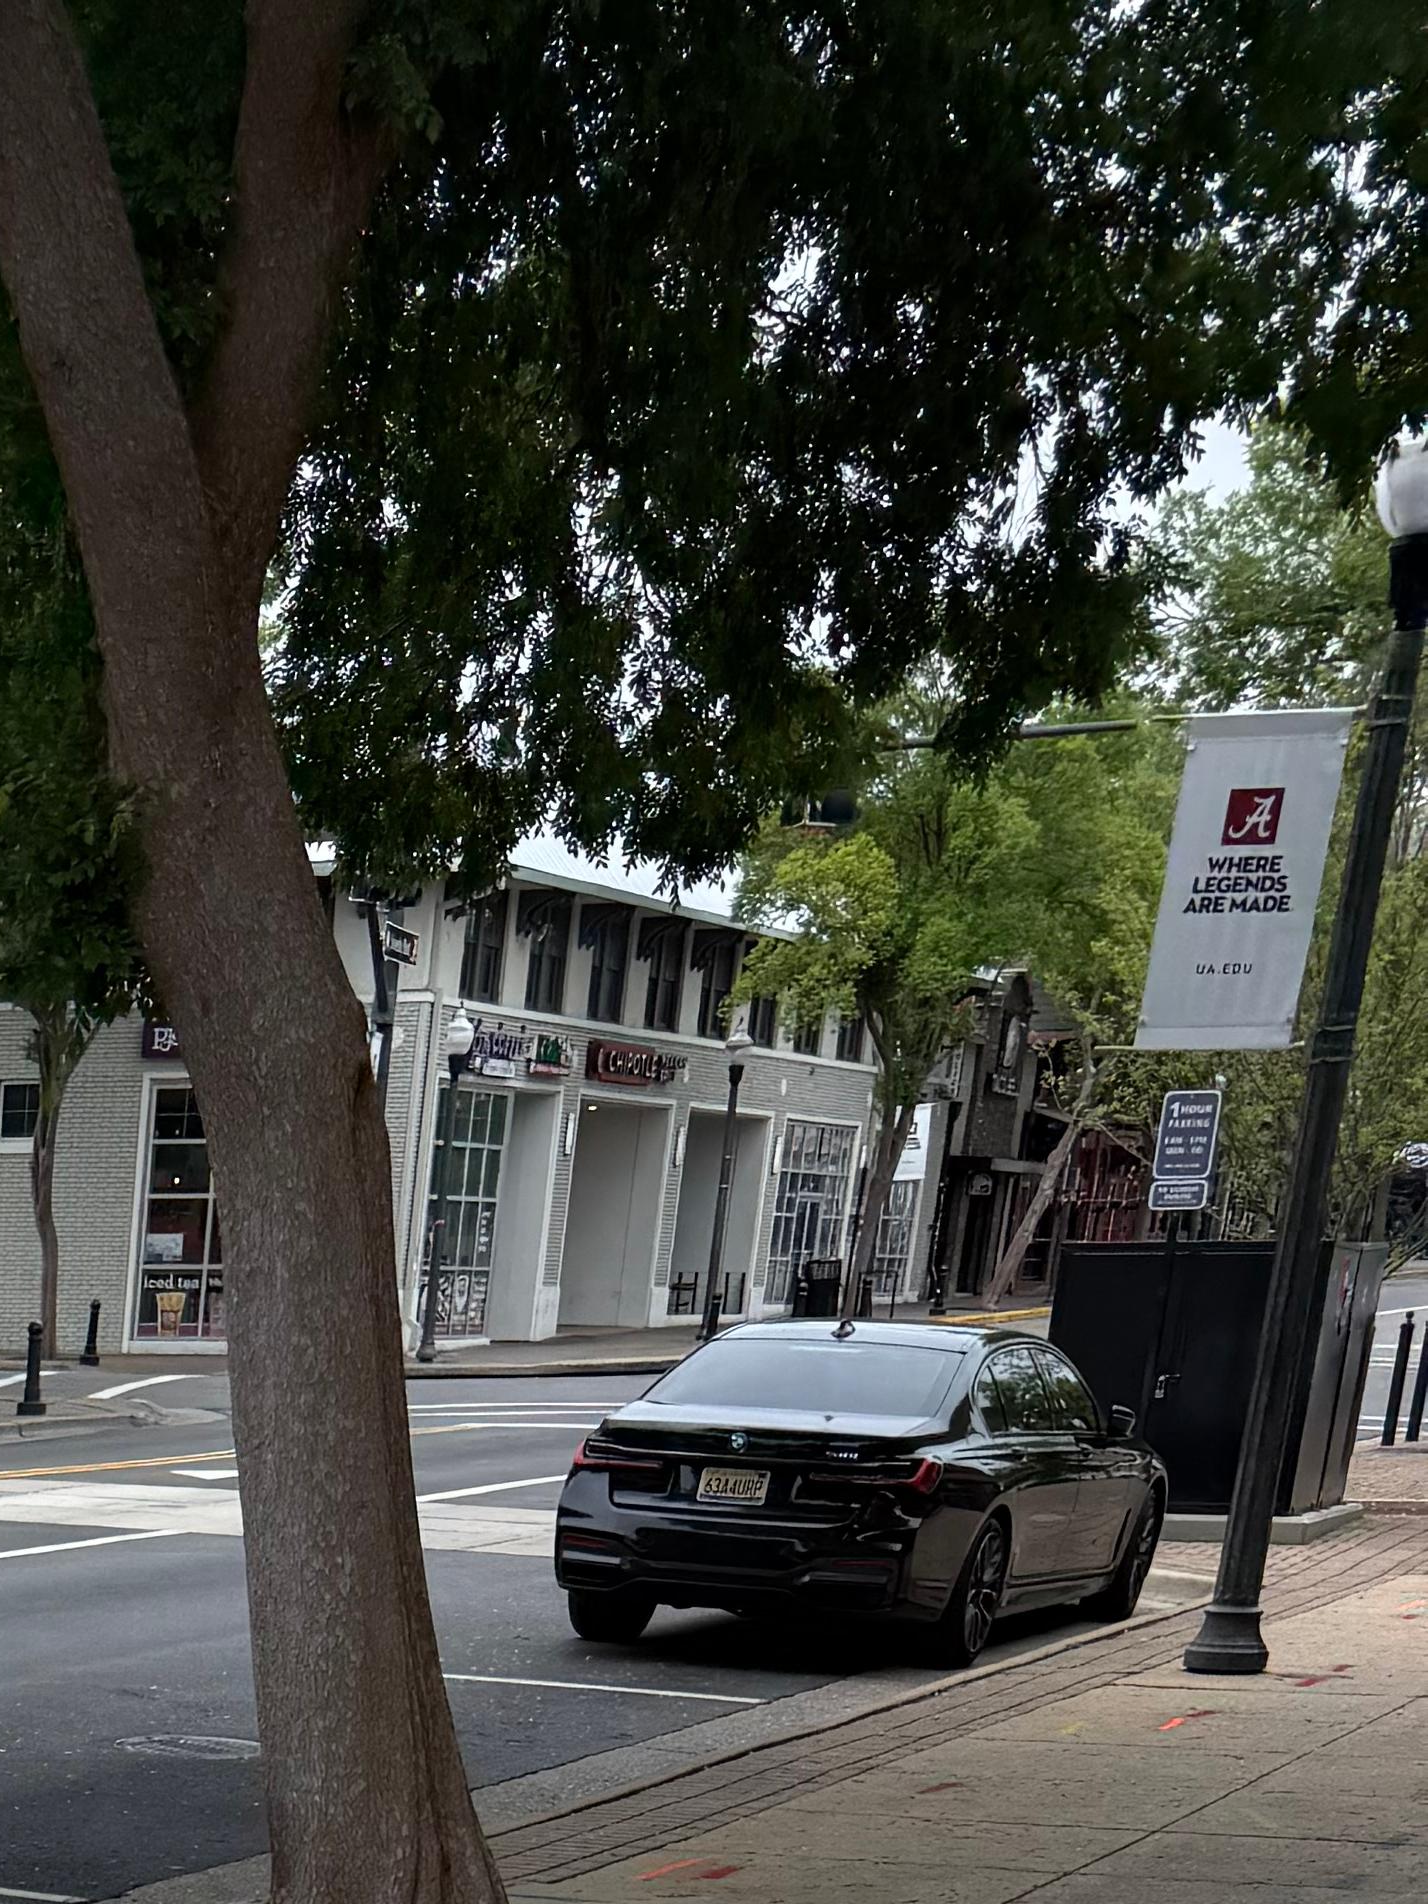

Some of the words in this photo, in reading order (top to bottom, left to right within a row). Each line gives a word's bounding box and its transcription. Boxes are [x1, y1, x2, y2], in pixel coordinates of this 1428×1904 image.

[1208, 855, 1283, 873] WHERE
[1192, 875, 1288, 894] LEGENDS
[1183, 896, 1229, 914] ARE
[1229, 895, 1291, 913] MADE
[1196, 963, 1253, 975] UA.EDU
[609, 1050, 658, 1079] CHIPOTLE
[1170, 1101, 1180, 1118] 1
[1180, 1104, 1213, 1114] HOUR
